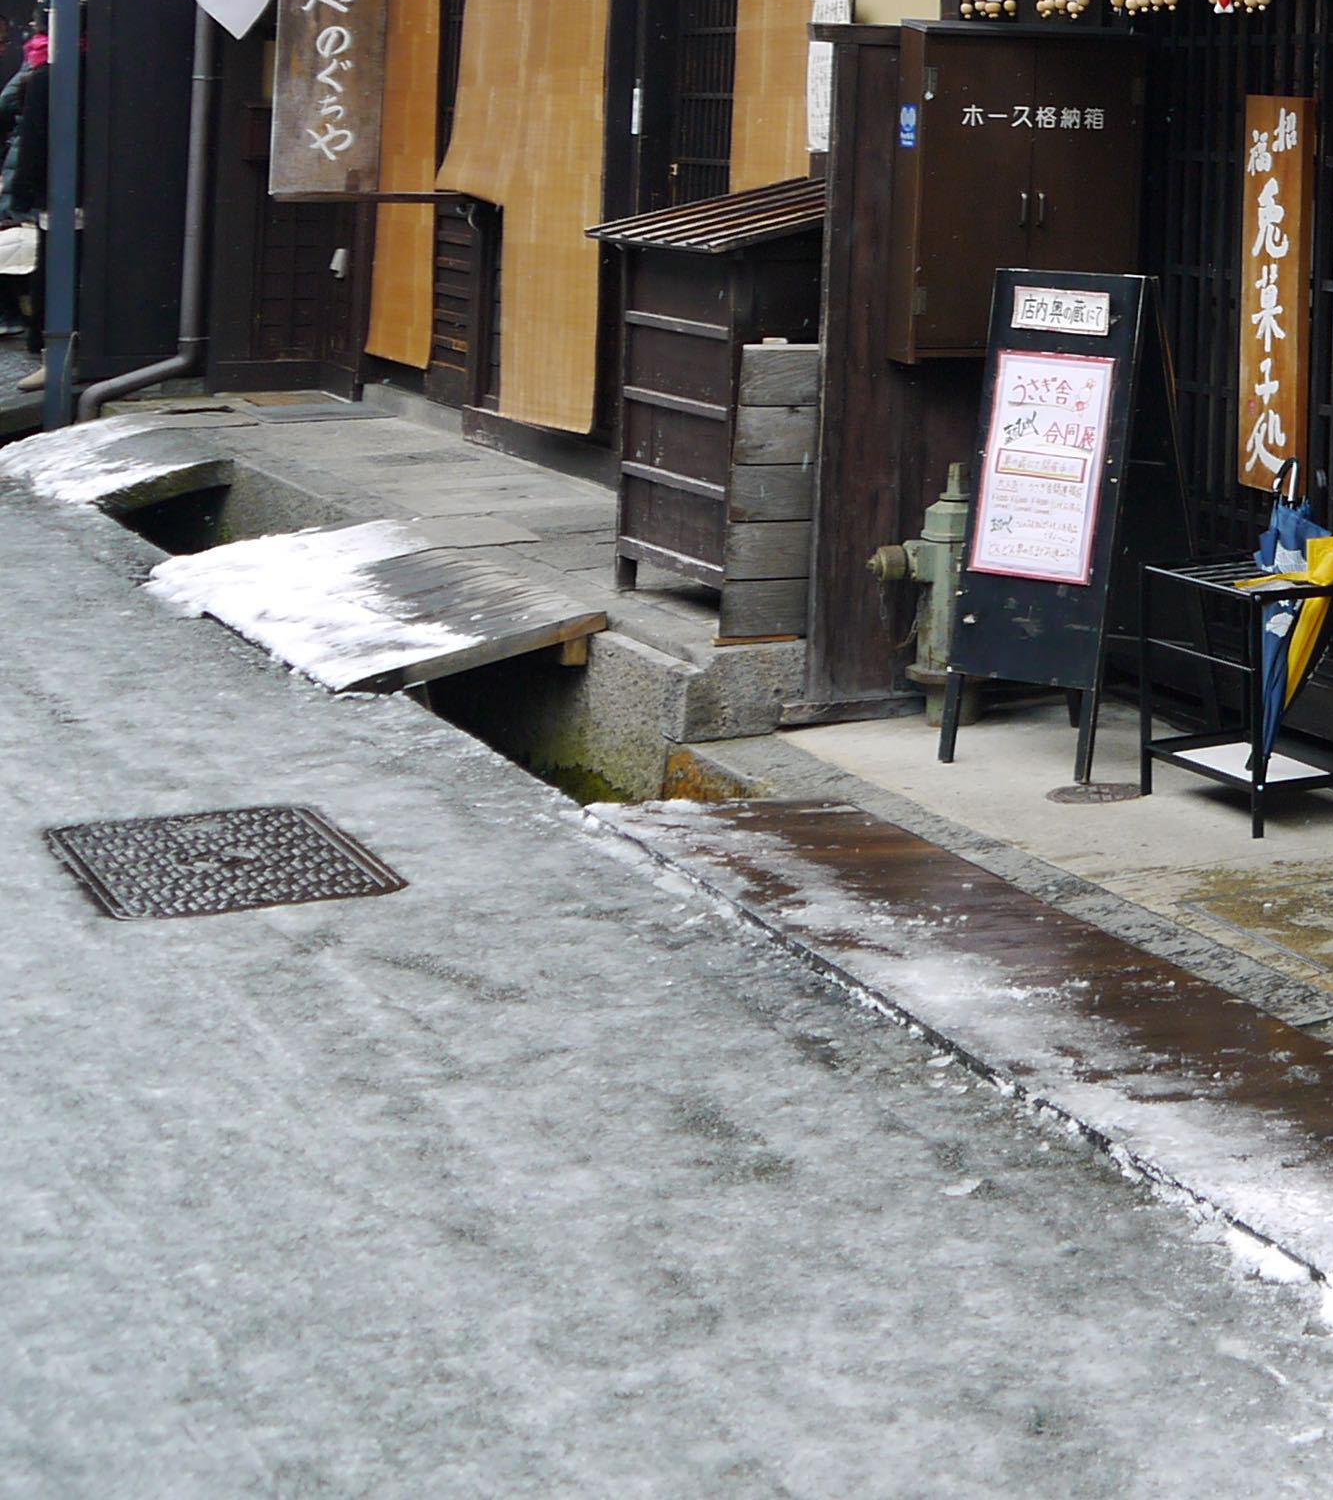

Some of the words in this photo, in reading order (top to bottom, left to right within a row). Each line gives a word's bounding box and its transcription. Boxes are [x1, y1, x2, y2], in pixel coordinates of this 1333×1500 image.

[961, 104, 1105, 130] ホース格納箱
[1012, 375, 1073, 406] うさぎ舎
